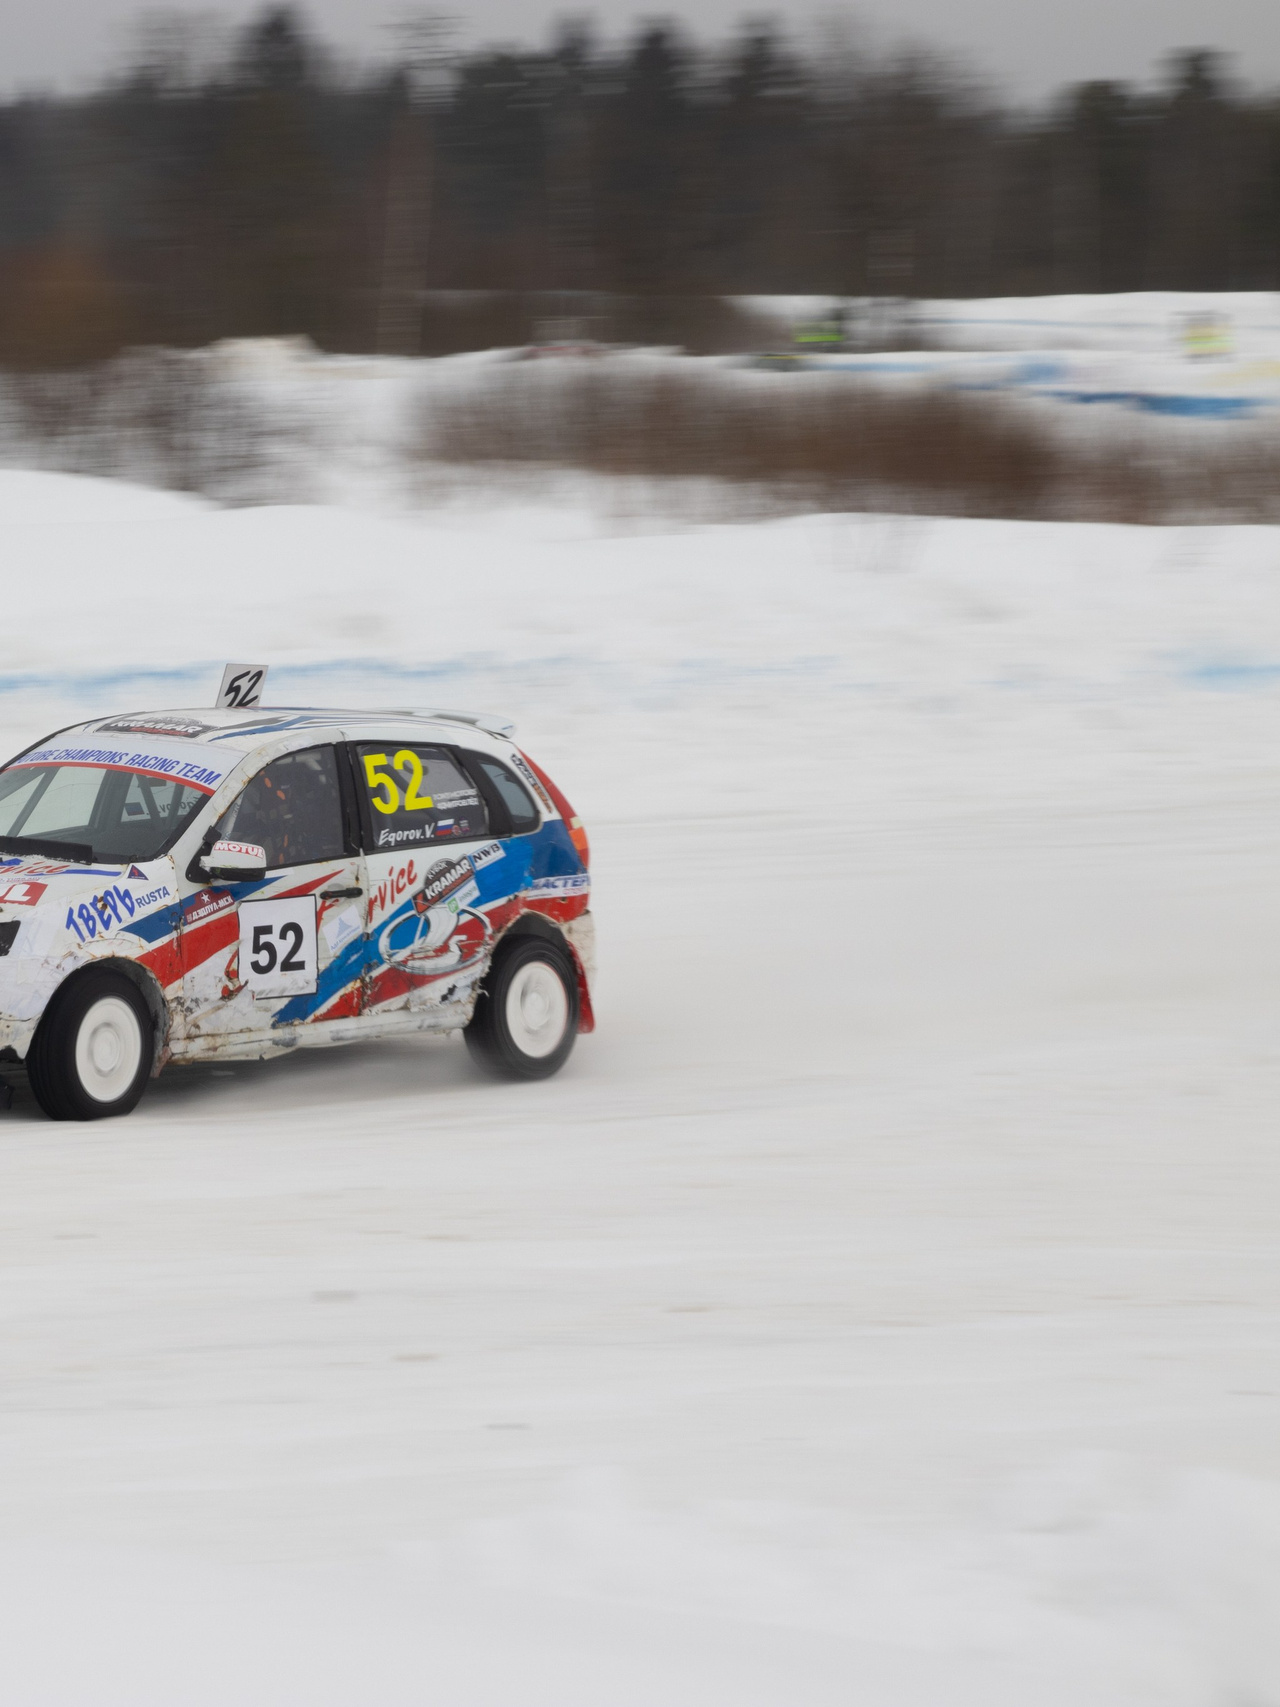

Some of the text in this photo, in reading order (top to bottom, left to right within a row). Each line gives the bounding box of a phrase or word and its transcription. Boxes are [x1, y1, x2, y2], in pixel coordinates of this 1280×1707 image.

[224, 669, 263, 707] 52
[18, 748, 222, 785] UTURE CHAMPIONS RACING TEAM
[363, 750, 434, 814] 52
[214, 841, 265, 858] MOTUL
[135, 886, 170, 908] RUSTA
[424, 859, 472, 900] KRAMAR
[66, 885, 135, 943] ТВЕРЬ
[250, 922, 306, 975] 52
